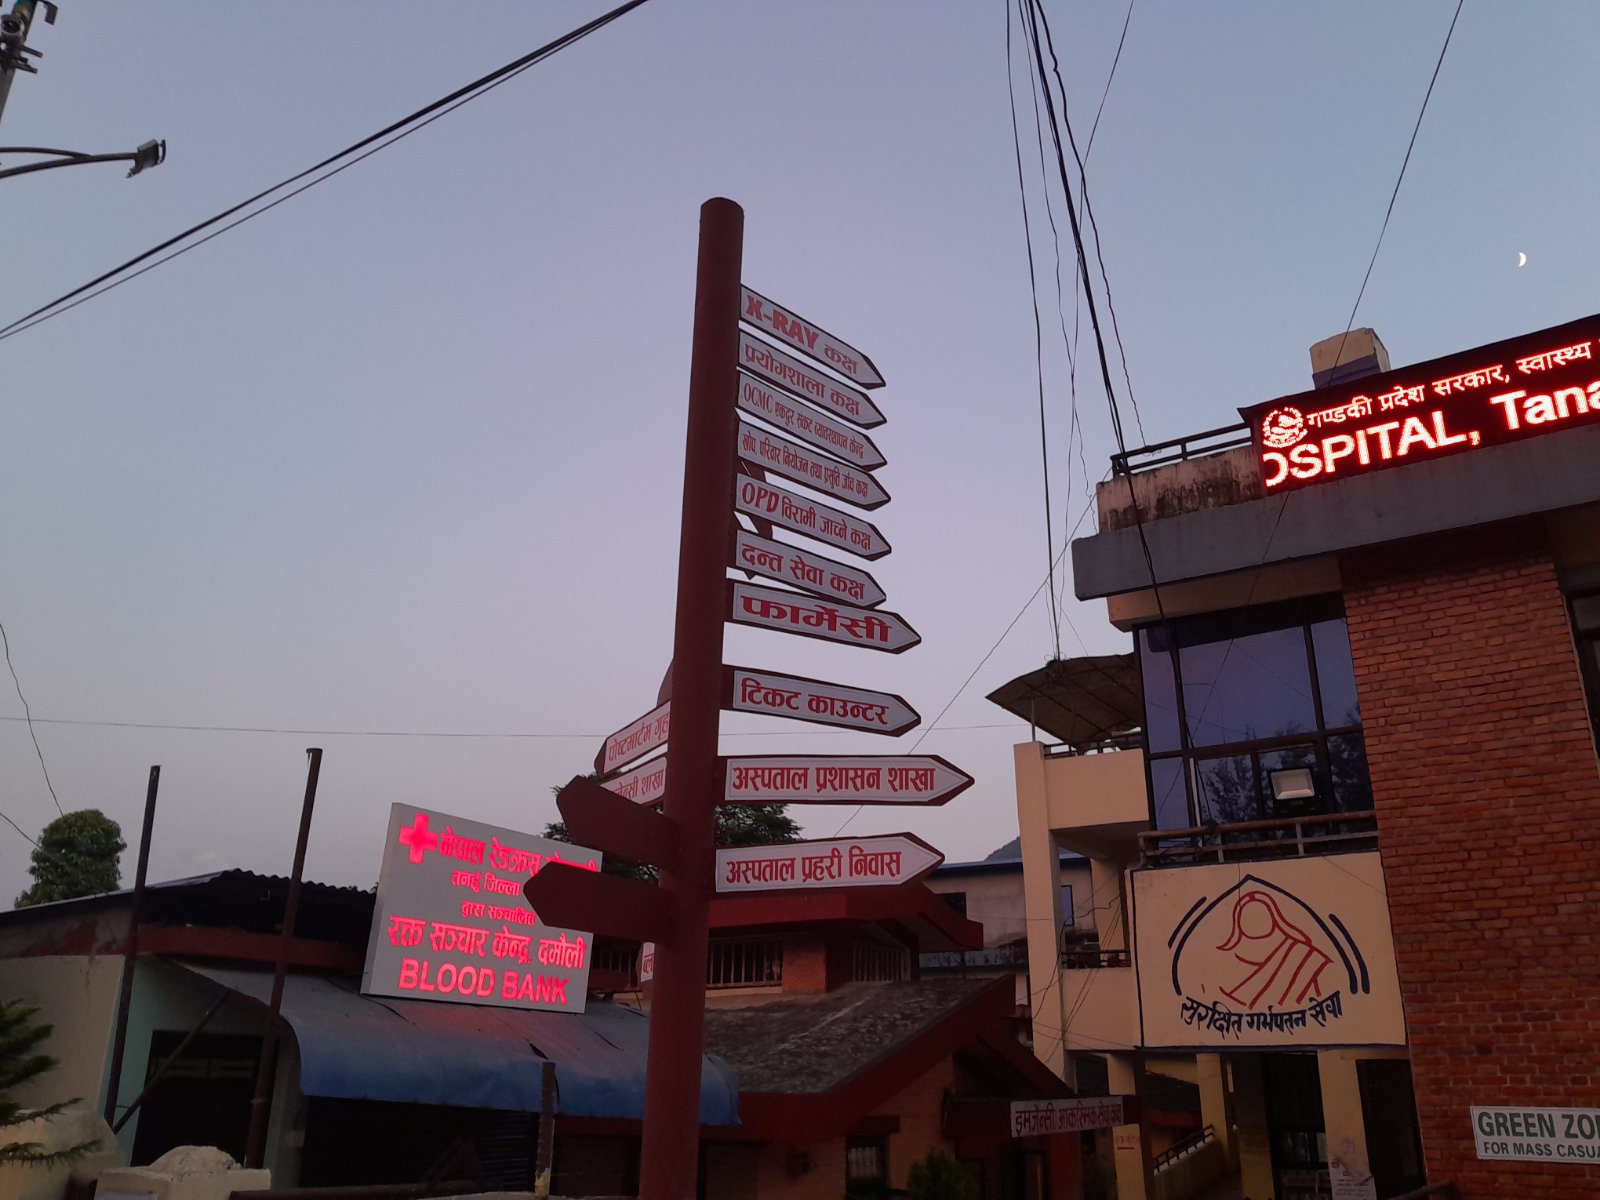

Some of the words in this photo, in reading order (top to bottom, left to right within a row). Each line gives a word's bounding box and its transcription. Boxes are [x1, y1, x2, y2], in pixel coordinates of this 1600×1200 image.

[746, 294, 820, 349] X-RAY
[824, 344, 858, 375] कक्ष
[743, 382, 774, 413] OCMC
[744, 343, 826, 400] प्रयोगशाला
[830, 388, 861, 416] कक्ष
[1306, 396, 1373, 429] गण्डकी
[1378, 384, 1426, 412] प्रदेश
[1432, 364, 1511, 398] सरकार,
[1516, 341, 1593, 375] स्वास्थ्य
[759, 436, 782, 464] परिवार
[782, 445, 809, 474] नियोजन
[809, 460, 823, 480] तथा
[855, 479, 869, 499] कक्ष
[741, 482, 780, 513] OPD
[781, 496, 816, 529] विरामी
[850, 527, 872, 551] कक्ष
[741, 542, 784, 573] दन्त
[789, 555, 825, 587] सेवा
[830, 572, 865, 600] कक्ष
[740, 676, 802, 711] टिकट
[807, 693, 889, 725] काउन्टर
[641, 768, 665, 796] शाखा
[732, 766, 810, 792] अस्पताल
[815, 766, 882, 794] प्रशासन
[887, 766, 936, 793] शाखा
[439, 825, 487, 865] नेपाल
[726, 856, 796, 885] अस्पताल
[801, 847, 843, 883] प्रहरी
[848, 845, 902, 879] निवास
[483, 872, 522, 897] जिल्ला
[387, 915, 426, 947] रक्त
[429, 921, 490, 958] सञ्चार
[537, 933, 586, 969] दमौली
[398, 957, 496, 998] BLOOD
[501, 970, 569, 1006] BANK
[1180, 996, 1244, 1041] सुरक्षित
[1245, 1005, 1307, 1036] गर्भपतन
[1308, 990, 1343, 1028] सेवा
[1477, 1111, 1556, 1139] GREEN
[1483, 1141, 1509, 1155] FOR
[1513, 1143, 1553, 1157] MASS
